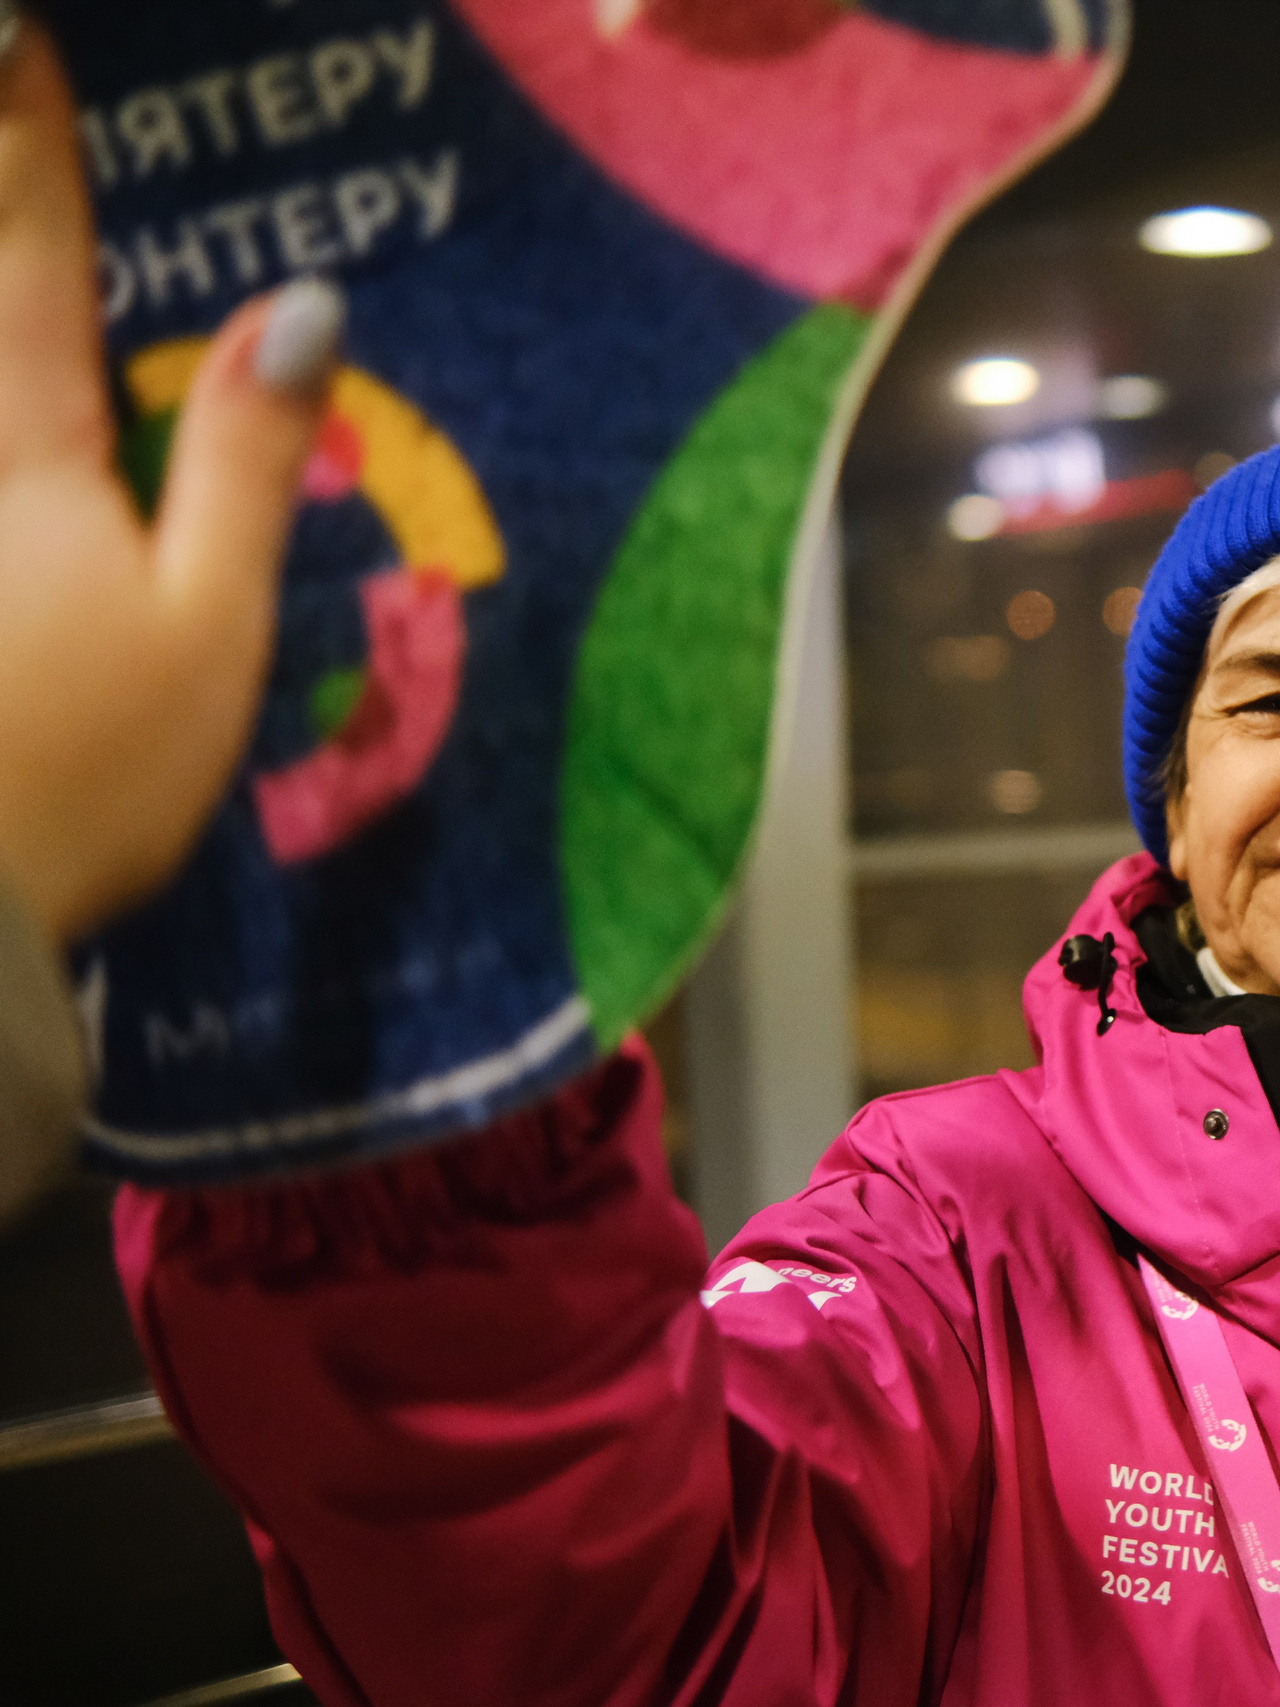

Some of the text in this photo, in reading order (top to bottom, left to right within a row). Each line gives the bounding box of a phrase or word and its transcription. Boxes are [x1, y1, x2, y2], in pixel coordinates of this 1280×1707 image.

[1105, 1499, 1215, 1537] YOUTH
[1102, 1535, 1230, 1579] FESTIVA
[1247, 1521, 1269, 1571] WORLD YOUTH
[1101, 1570, 1172, 1605] 2024
